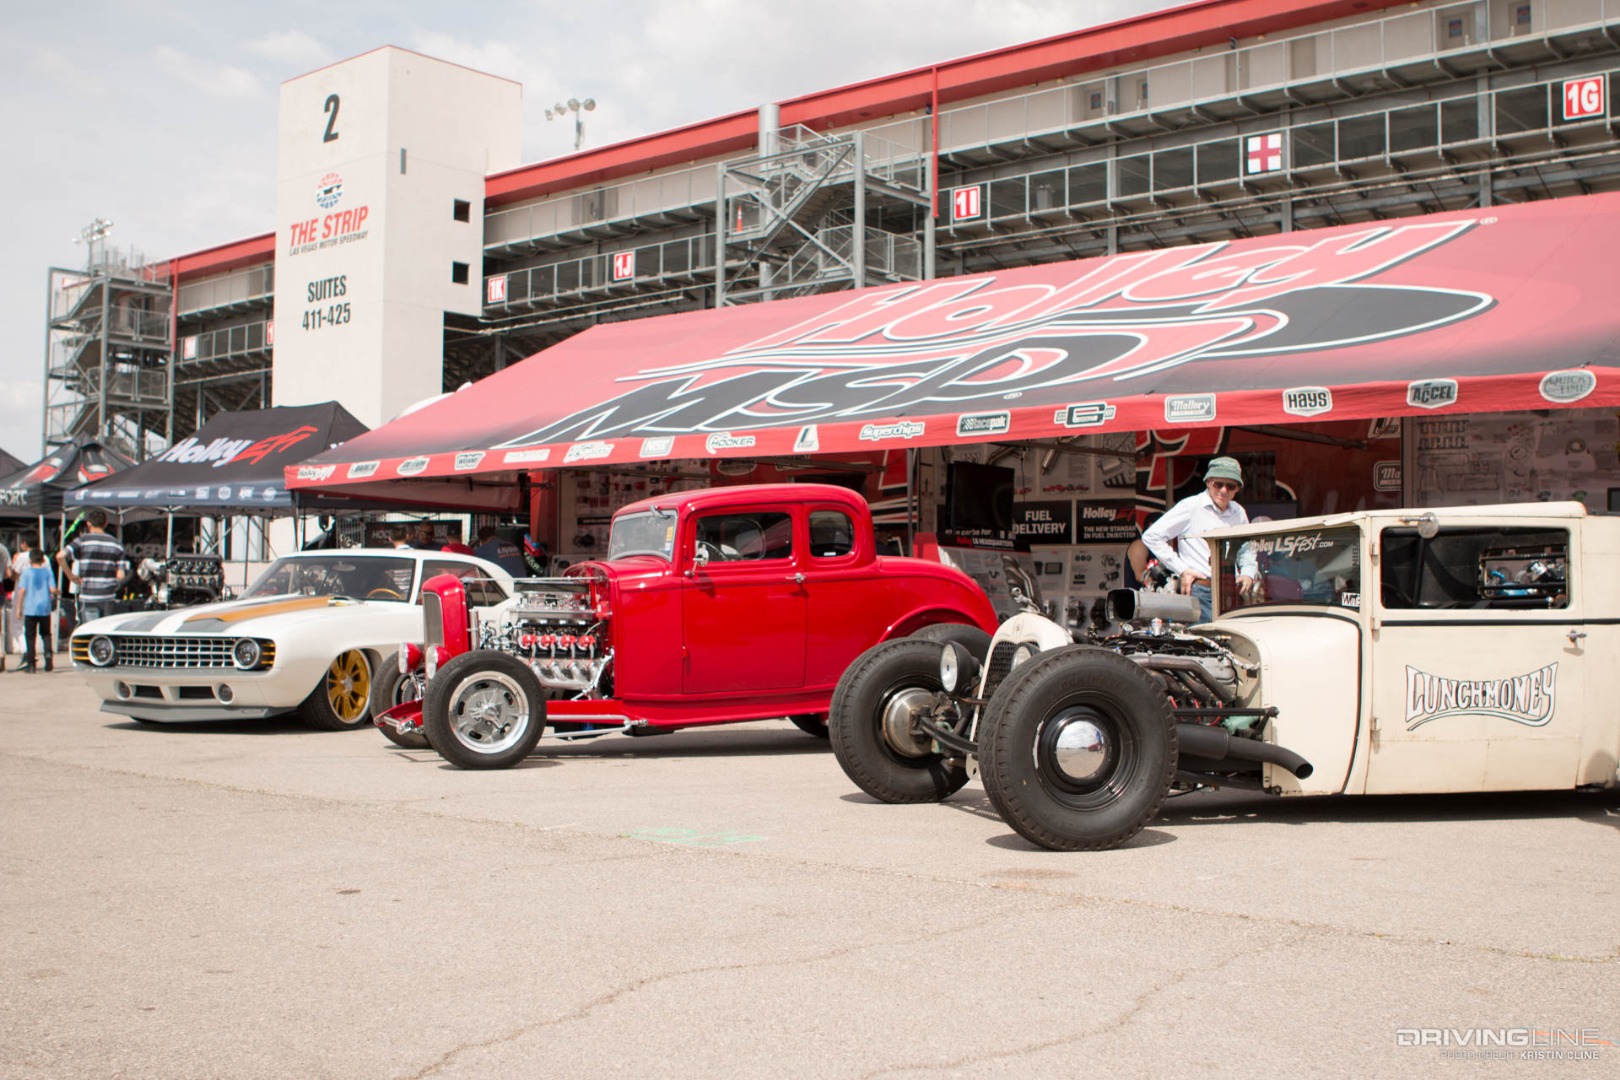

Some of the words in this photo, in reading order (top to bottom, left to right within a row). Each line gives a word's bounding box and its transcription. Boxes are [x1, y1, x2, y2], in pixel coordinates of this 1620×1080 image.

[1567, 80, 1599, 114] 1G
[323, 93, 340, 144] 2
[291, 218, 319, 247] THE
[322, 205, 369, 239] STRIP
[290, 246, 299, 257] LAS
[301, 242, 317, 254] VEGAS
[319, 237, 338, 249] MOTOR
[339, 230, 368, 245] SPEEDWAY
[616, 253, 632, 279] 1J
[308, 275, 346, 302] SUITES
[491, 279, 505, 300] 1K
[302, 303, 351, 331] 411-425
[1548, 375, 1586, 386] QUICK
[1413, 383, 1453, 404] ACCEL
[1171, 399, 1210, 414] Mallory
[861, 423, 925, 439] Superchips
[156, 437, 254, 468] Holley
[710, 437, 755, 448] HOOKER
[1025, 510, 1053, 522] FUEL
[1082, 507, 1117, 522] Holley
[1013, 522, 1067, 534] DELIVERY
